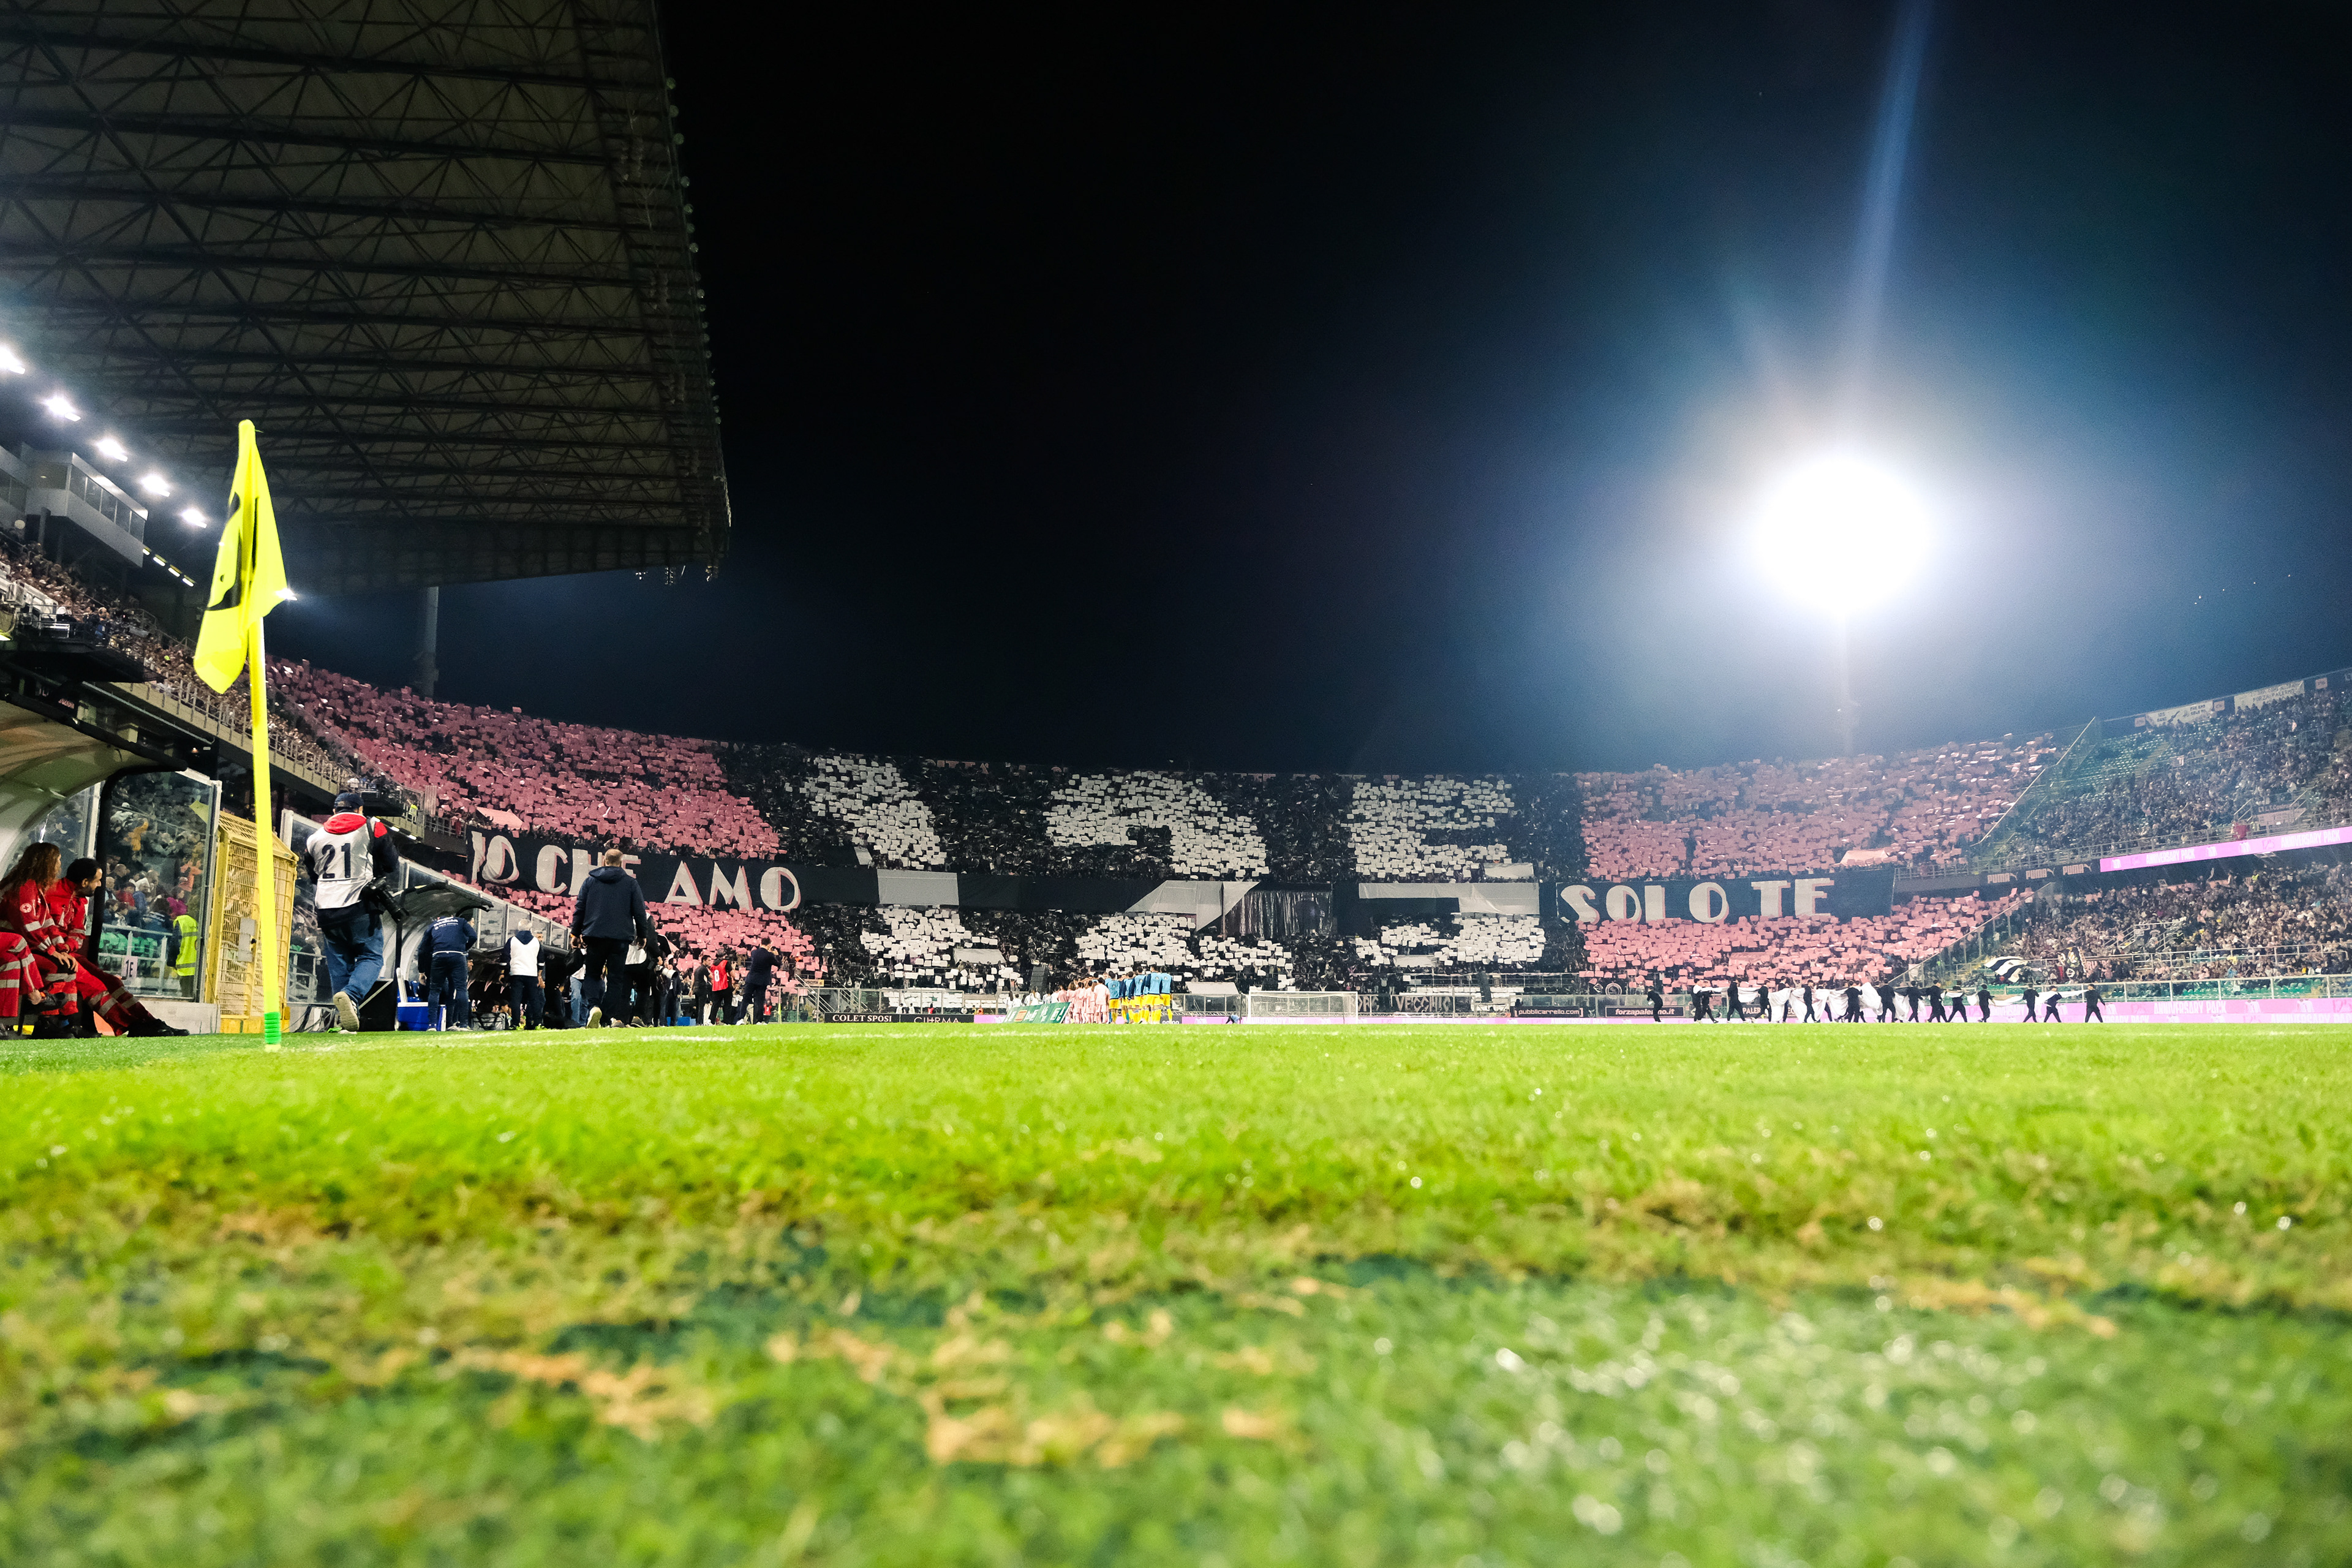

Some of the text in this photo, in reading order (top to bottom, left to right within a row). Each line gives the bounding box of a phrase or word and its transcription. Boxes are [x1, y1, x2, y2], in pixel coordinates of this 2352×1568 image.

[2281, 834, 2321, 848] ANNIVERSARY
[2323, 830, 2340, 843] PACK
[322, 843, 351, 879] 21
[2146, 848, 2195, 865] ANNIVERSARY PACK
[2026, 869, 2047, 880] PUMA
[2062, 864, 2084, 876] PUMA
[1987, 873, 2010, 884] PUMA
[664, 860, 801, 913] AMO
[1560, 878, 1835, 924] SOLO TE
[714, 969, 720, 982] 8
[2154, 1001, 2203, 1014] ANNIVERSARY
[2206, 1001, 2227, 1014] PACK
[2333, 1013, 2352, 1023] PAC
